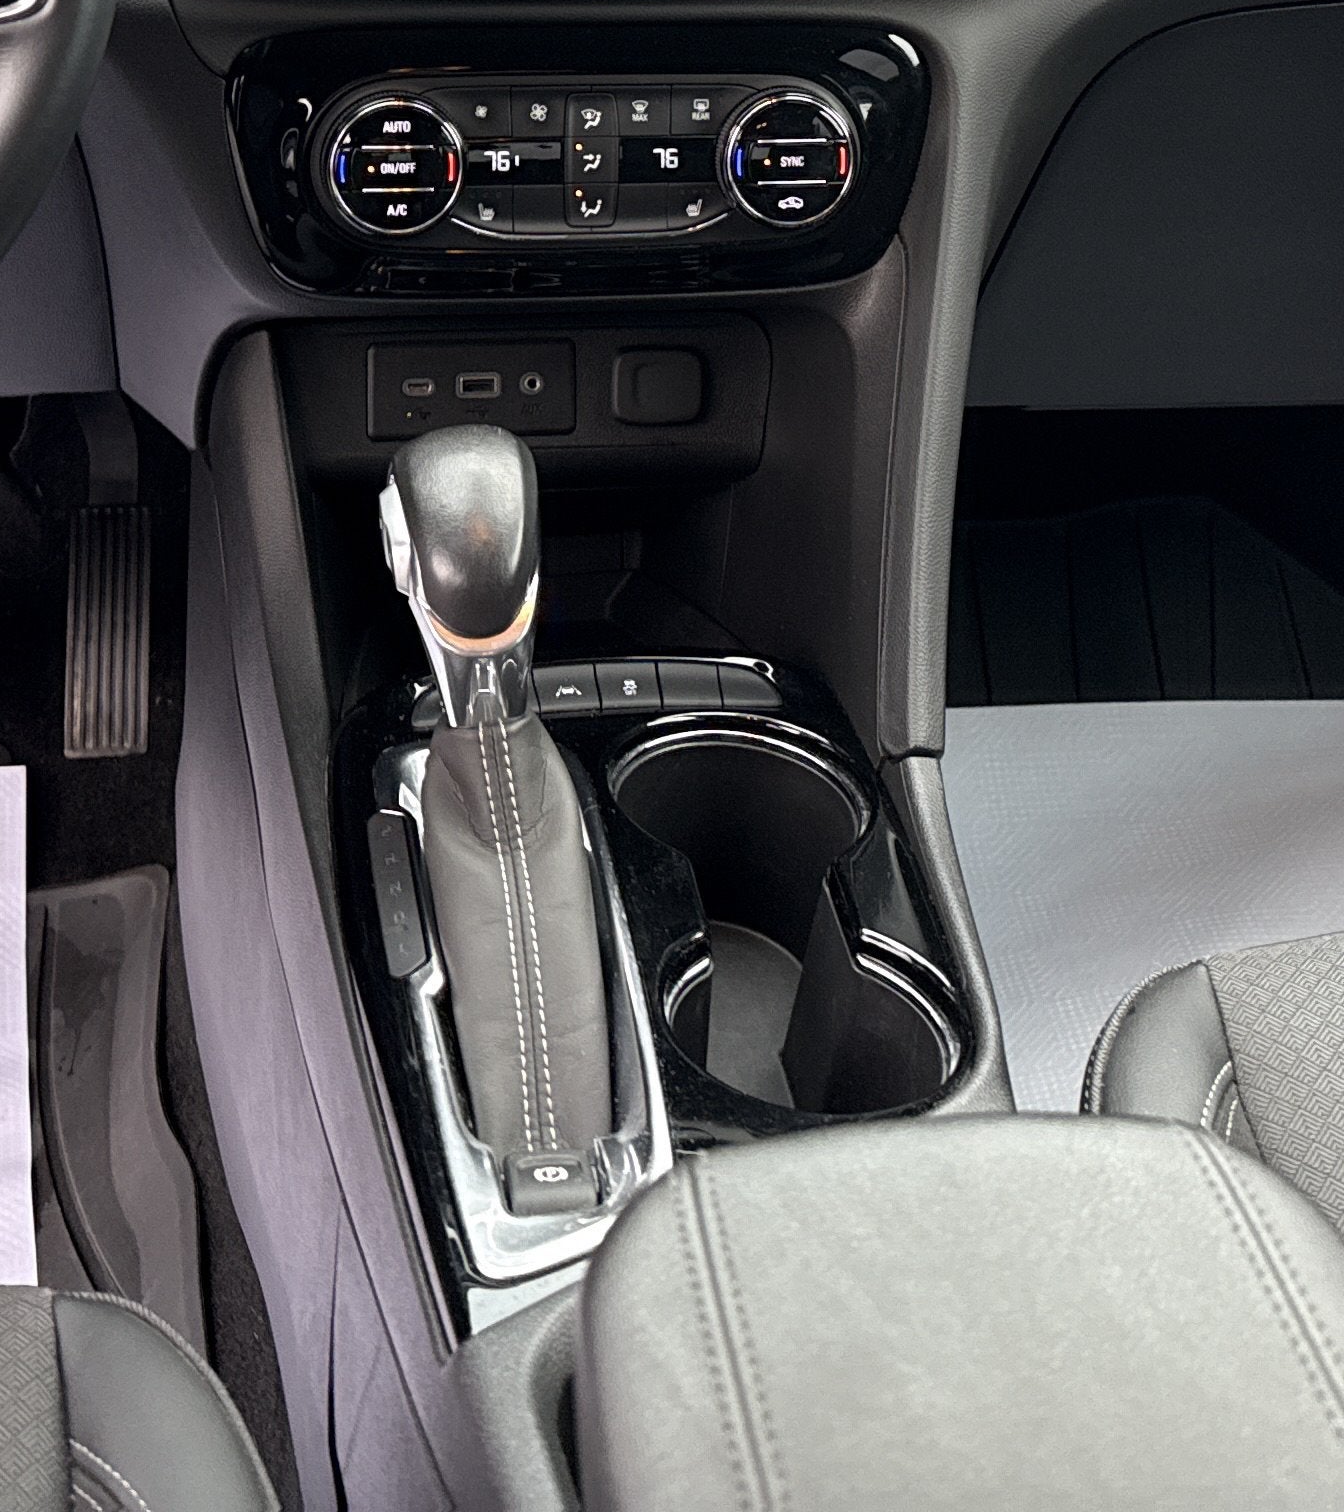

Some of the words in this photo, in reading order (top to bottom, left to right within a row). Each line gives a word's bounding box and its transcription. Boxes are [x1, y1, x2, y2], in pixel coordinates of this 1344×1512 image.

[632, 113, 649, 123] MAX
[382, 120, 411, 134] AUTO
[484, 150, 510, 172] 76
[652, 148, 679, 169] 76
[779, 156, 805, 168] SYNC
[380, 161, 417, 175] ON/OFF
[386, 203, 408, 218] A/C
